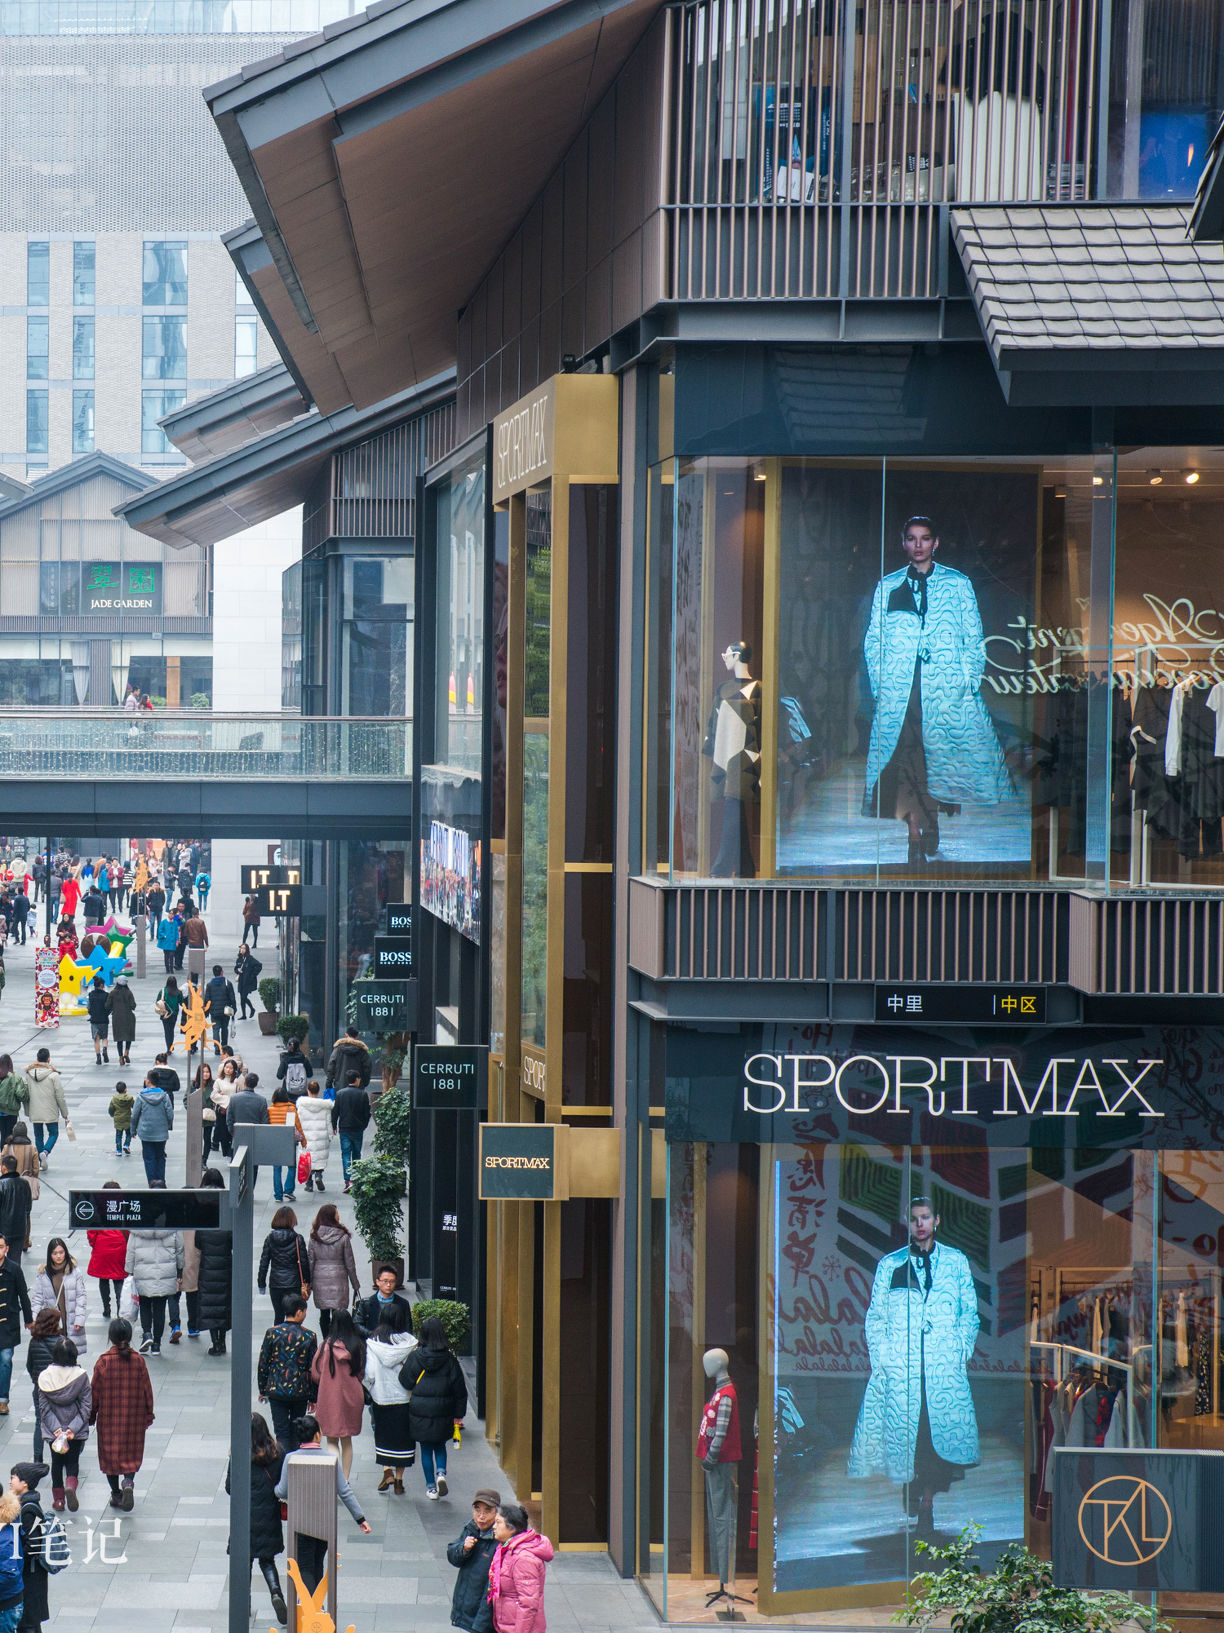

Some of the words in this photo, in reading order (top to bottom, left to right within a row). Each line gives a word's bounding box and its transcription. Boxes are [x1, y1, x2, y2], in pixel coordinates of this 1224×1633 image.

[90, 599, 115, 610] JADE
[113, 599, 153, 609] GARDEN
[268, 890, 291, 912] I.T
[391, 916, 412, 926] BOS
[379, 951, 412, 962] BOSS
[360, 994, 404, 1003] CERRUTI
[887, 993, 923, 1013] 中里
[1001, 995, 1037, 1013] 中区
[370, 1007, 394, 1016] 1881
[420, 1063, 475, 1075] CERRUTI
[523, 1055, 545, 1093] SPOR
[433, 1078, 462, 1090] 1881
[743, 1053, 1165, 1117] SPORTMAX
[485, 1156, 550, 1169] SPORTMAX
[106, 1199, 141, 1213] 漫广场
[106, 1213, 124, 1221] TEMPLE
[126, 1213, 142, 1221] PLAZA
